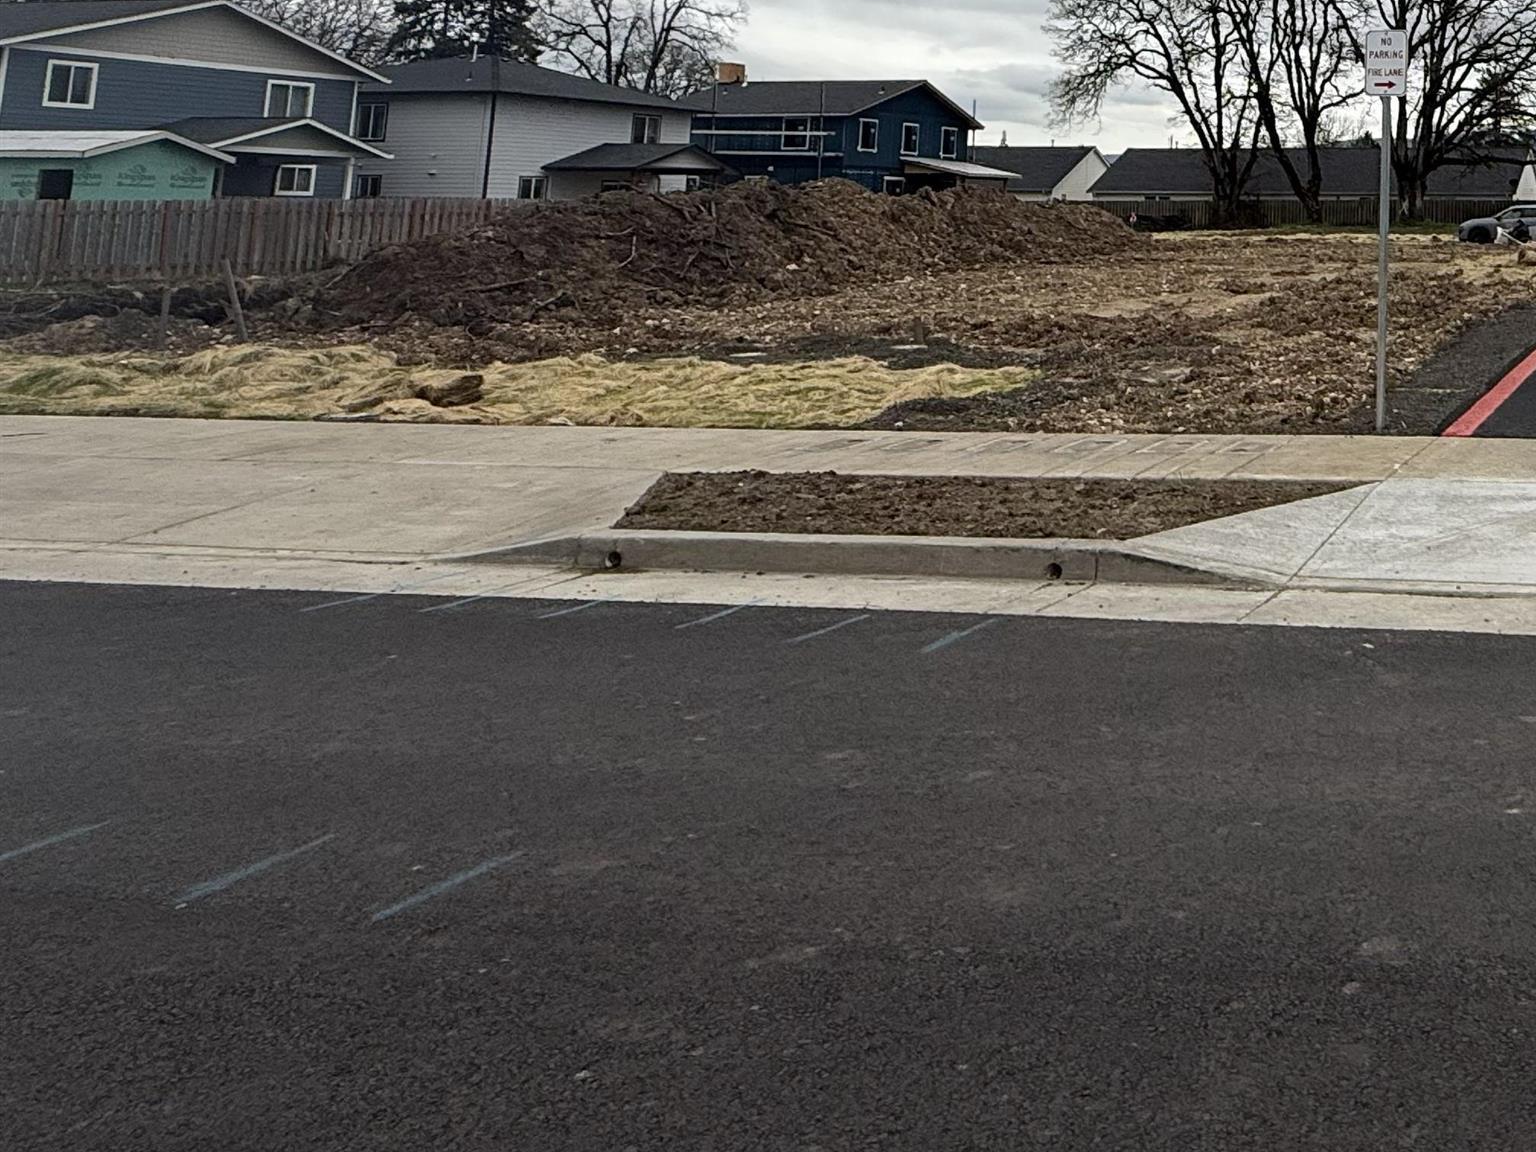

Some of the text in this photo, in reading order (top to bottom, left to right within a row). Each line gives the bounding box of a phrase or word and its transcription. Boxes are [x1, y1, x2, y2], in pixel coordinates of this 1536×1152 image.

[1381, 37, 1392, 46] NO
[1368, 50, 1404, 59] PARKING
[1384, 68, 1404, 76] LANE
